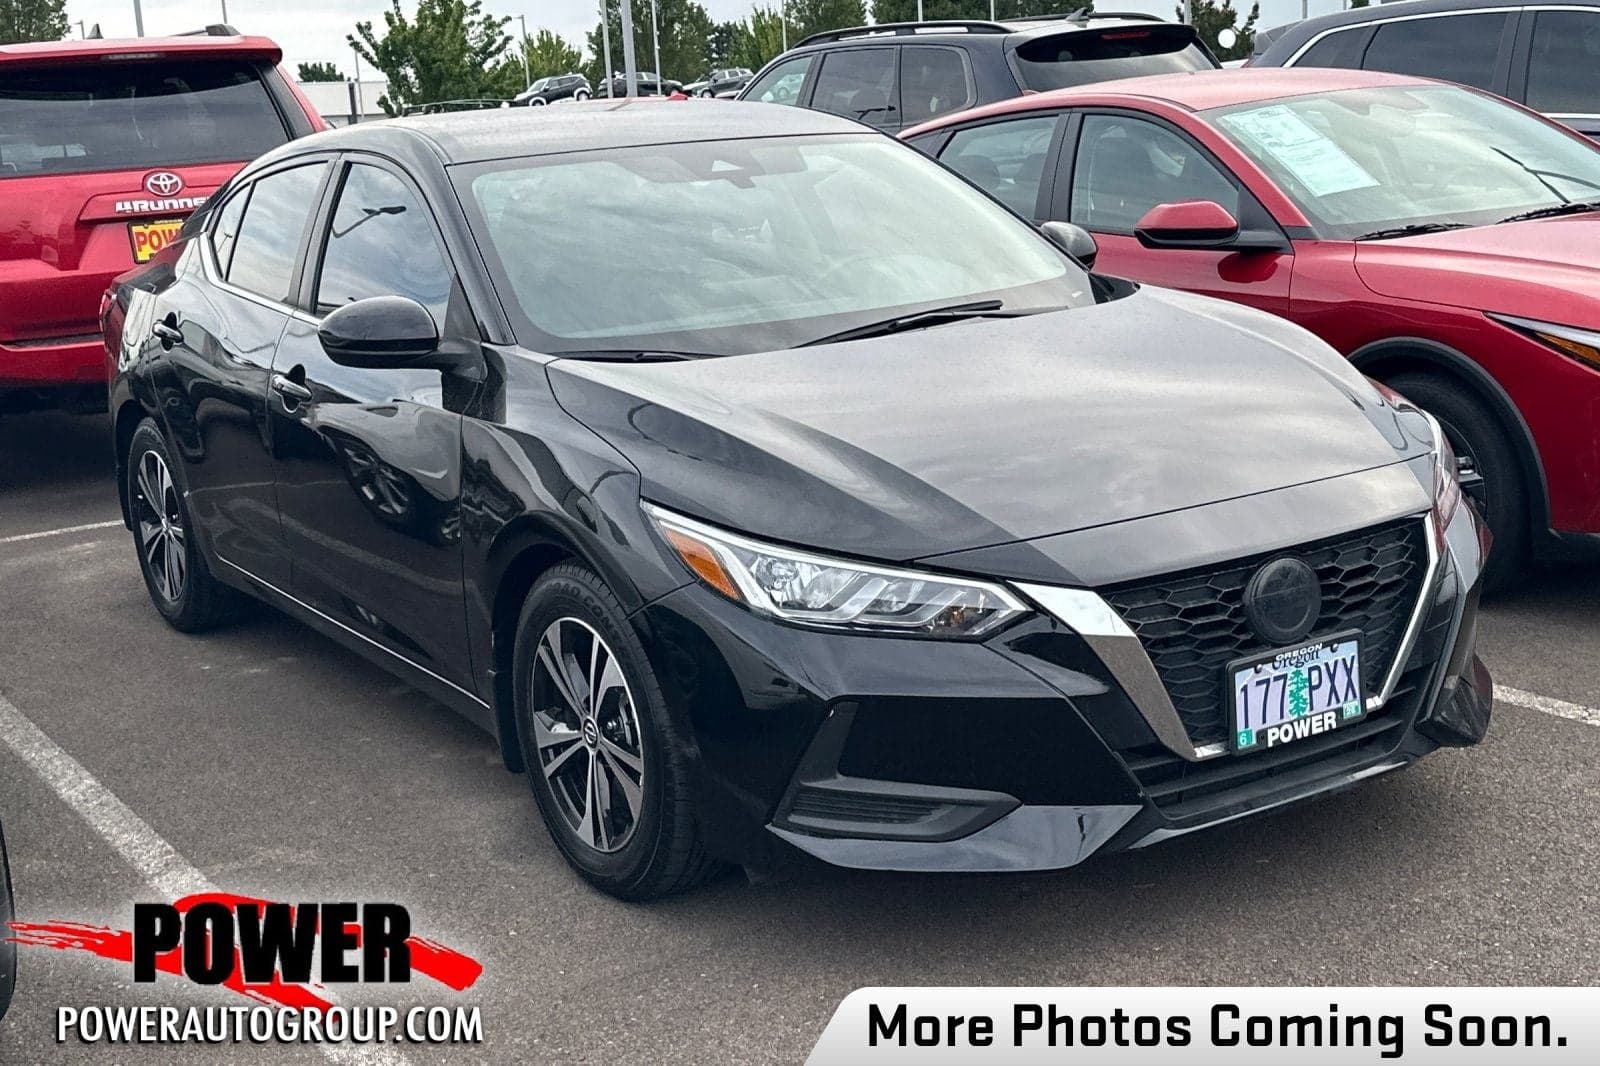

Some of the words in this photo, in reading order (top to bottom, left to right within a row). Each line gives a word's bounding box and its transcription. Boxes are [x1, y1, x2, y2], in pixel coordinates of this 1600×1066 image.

[116, 197, 209, 212] 4RUNNE
[1275, 643, 1323, 661] OREGON
[1240, 673, 1289, 729] 177
[1307, 655, 1358, 712] PXX
[1267, 711, 1337, 748] POWER
